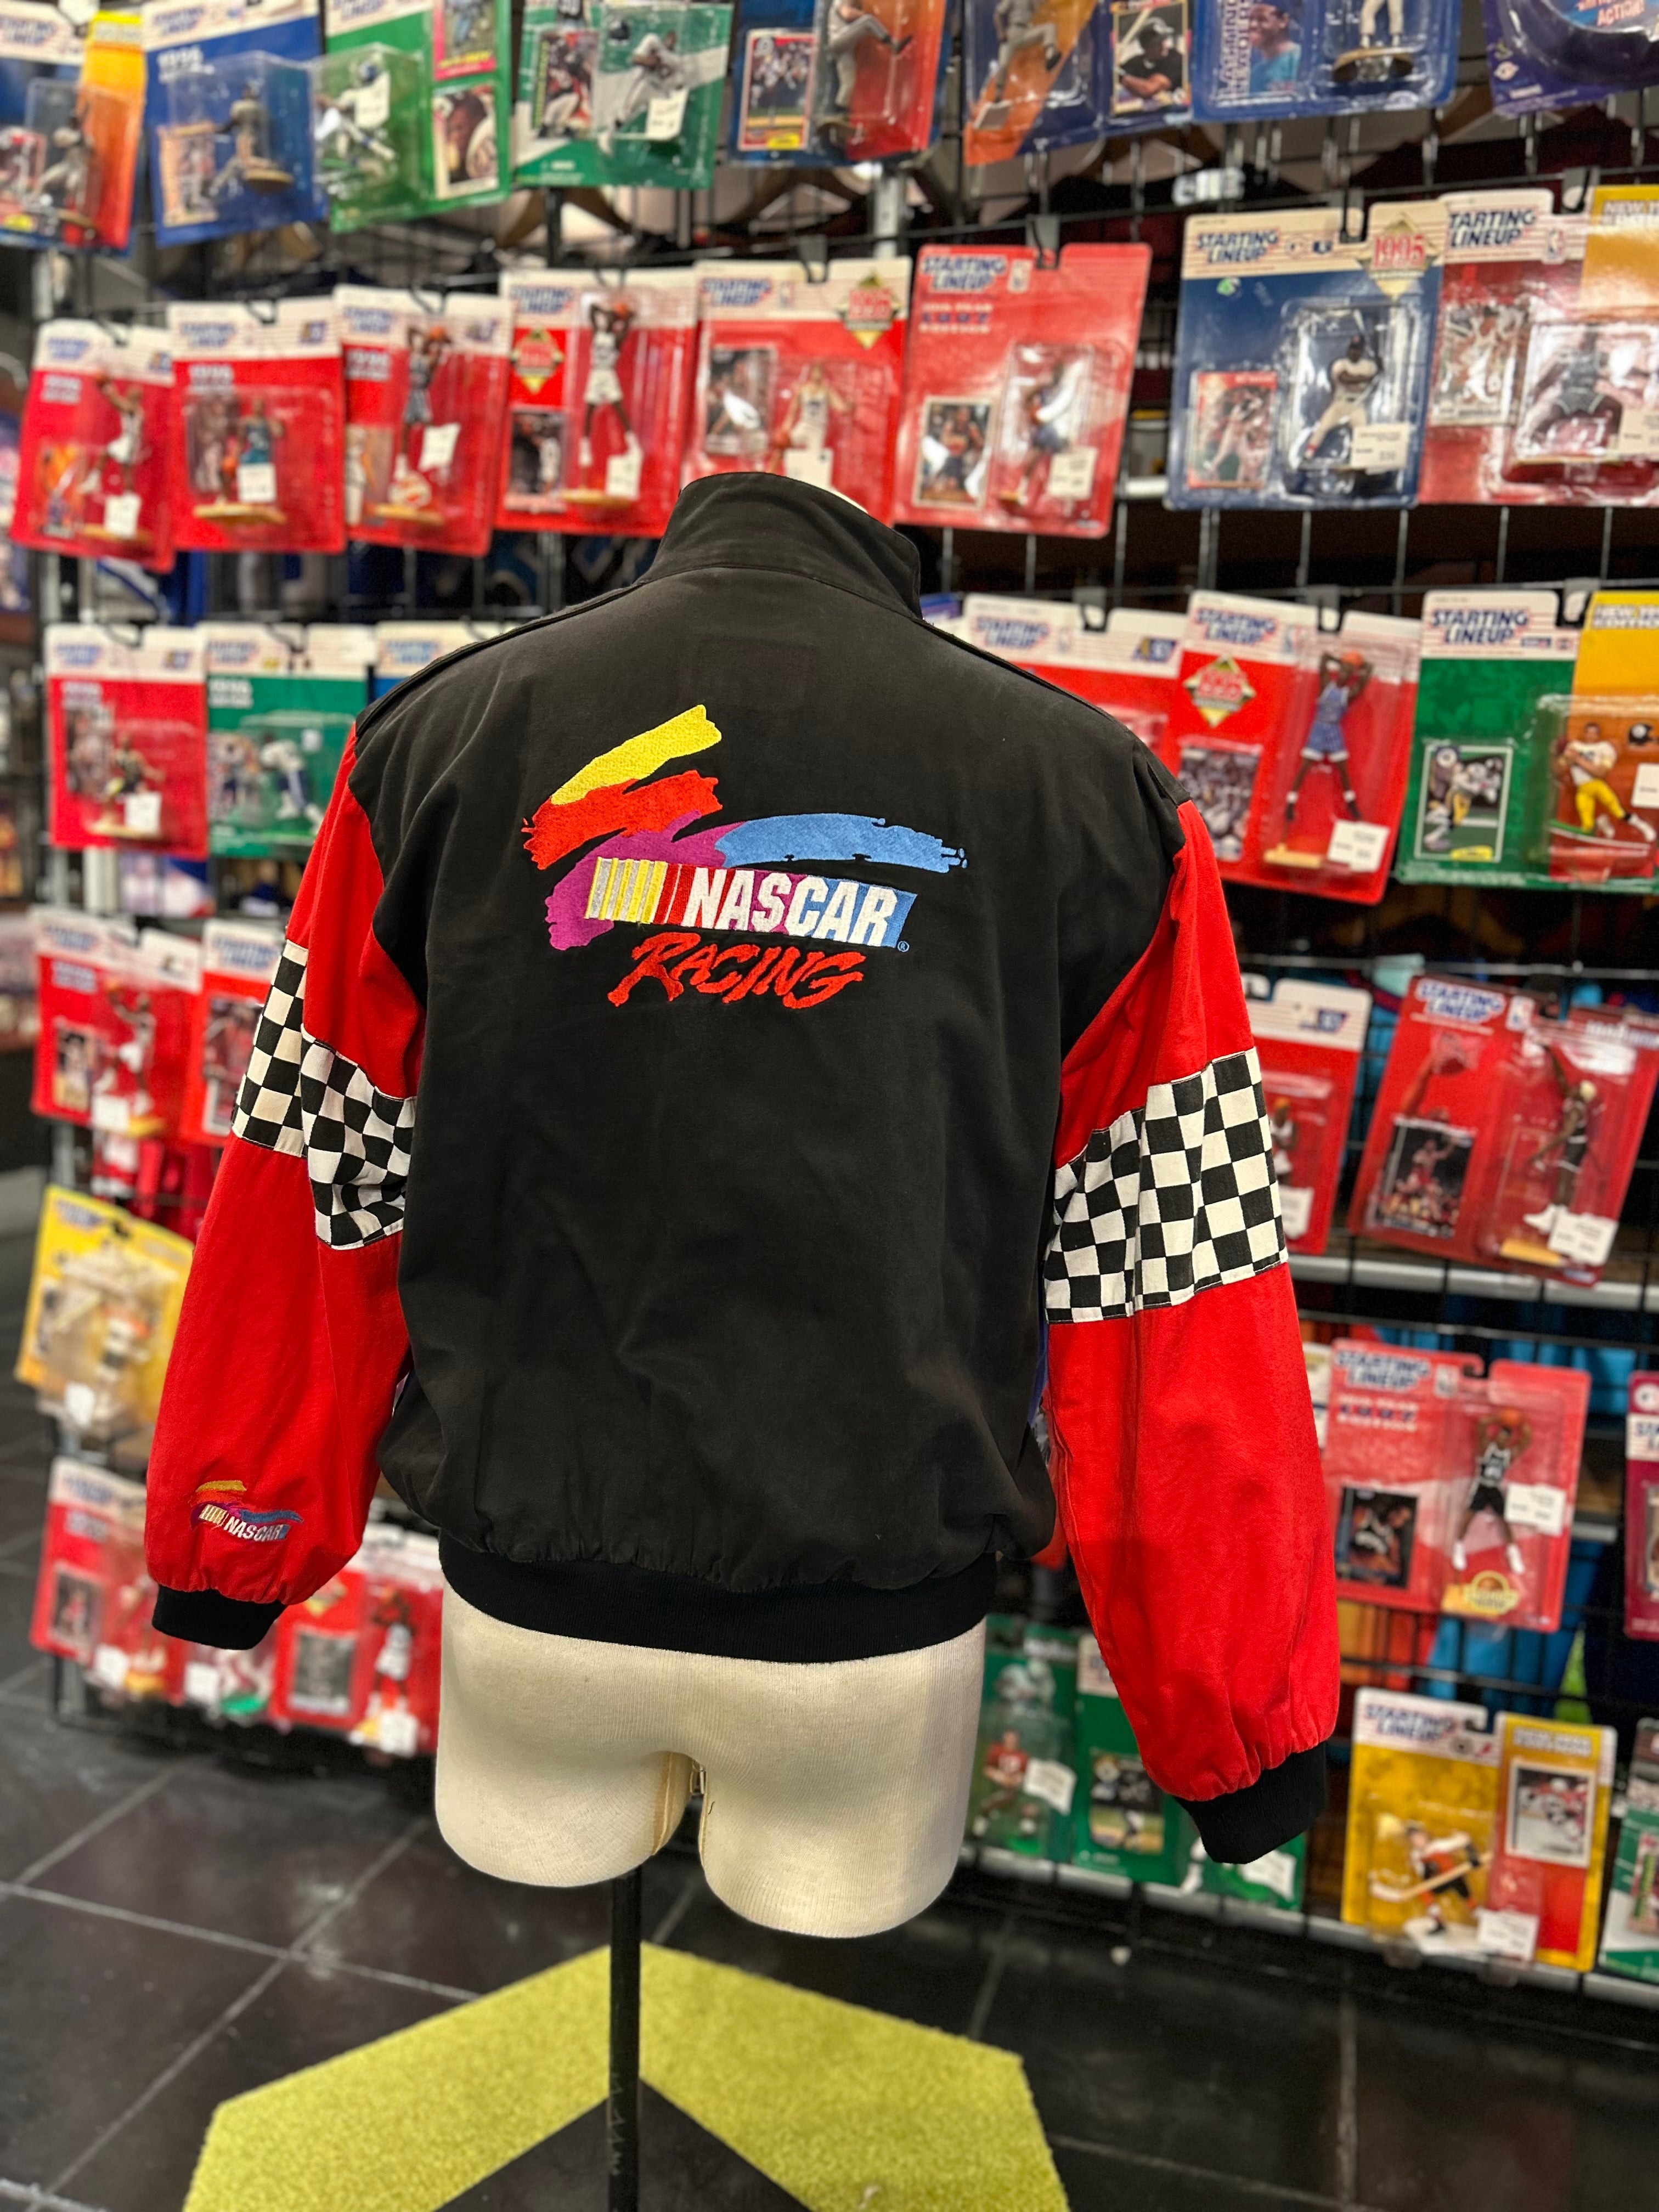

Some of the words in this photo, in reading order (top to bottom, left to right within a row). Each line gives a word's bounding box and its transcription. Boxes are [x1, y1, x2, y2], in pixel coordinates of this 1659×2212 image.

[1450, 210, 1536, 228] TARTING
[1197, 226, 1278, 249] STARTING
[1451, 226, 1521, 247] LINEUP
[1209, 245, 1267, 263] LINEUP
[1431, 609, 1528, 628] STARTING
[1444, 627, 1514, 645] LINEUP
[682, 867, 898, 947] NASCAR
[607, 933, 866, 1009] RACING
[223, 1516, 284, 1542] NASCAR
